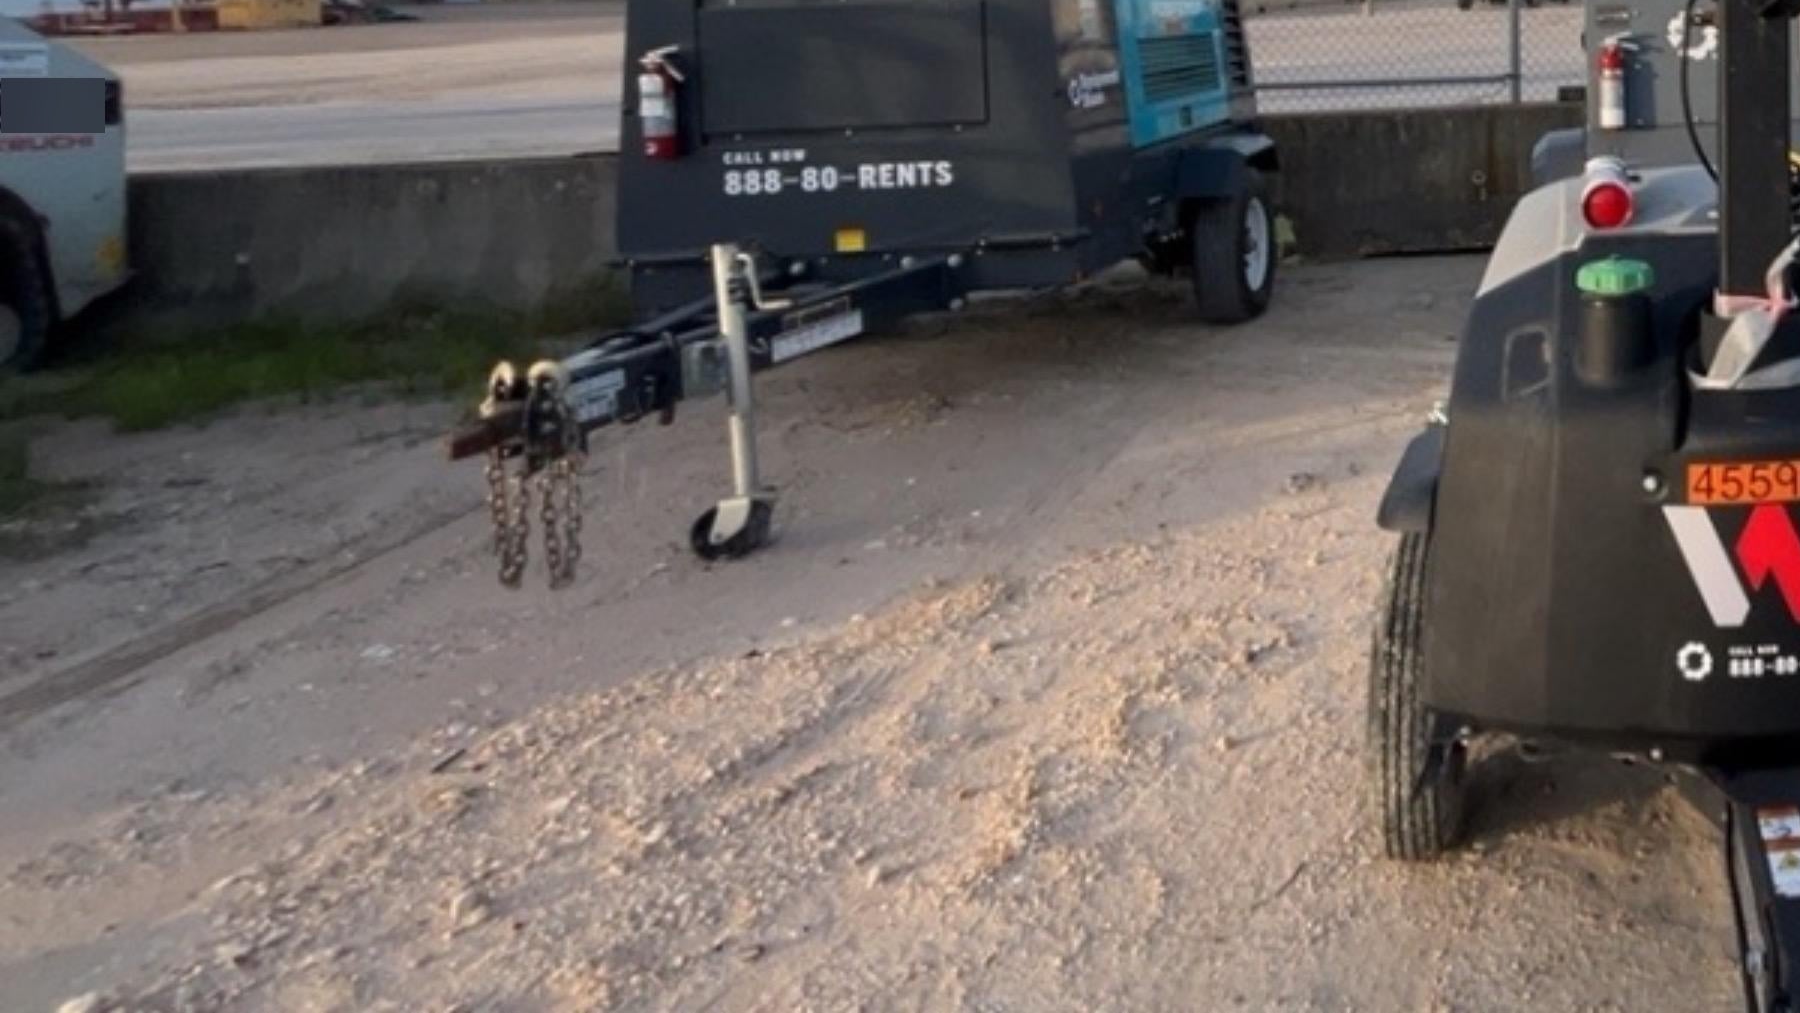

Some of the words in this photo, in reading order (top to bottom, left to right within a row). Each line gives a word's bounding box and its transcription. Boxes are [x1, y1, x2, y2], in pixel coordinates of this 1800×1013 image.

[723, 151, 763, 165] CALL
[769, 148, 807, 162] NOW
[724, 160, 953, 195] 888-80-RENTS
